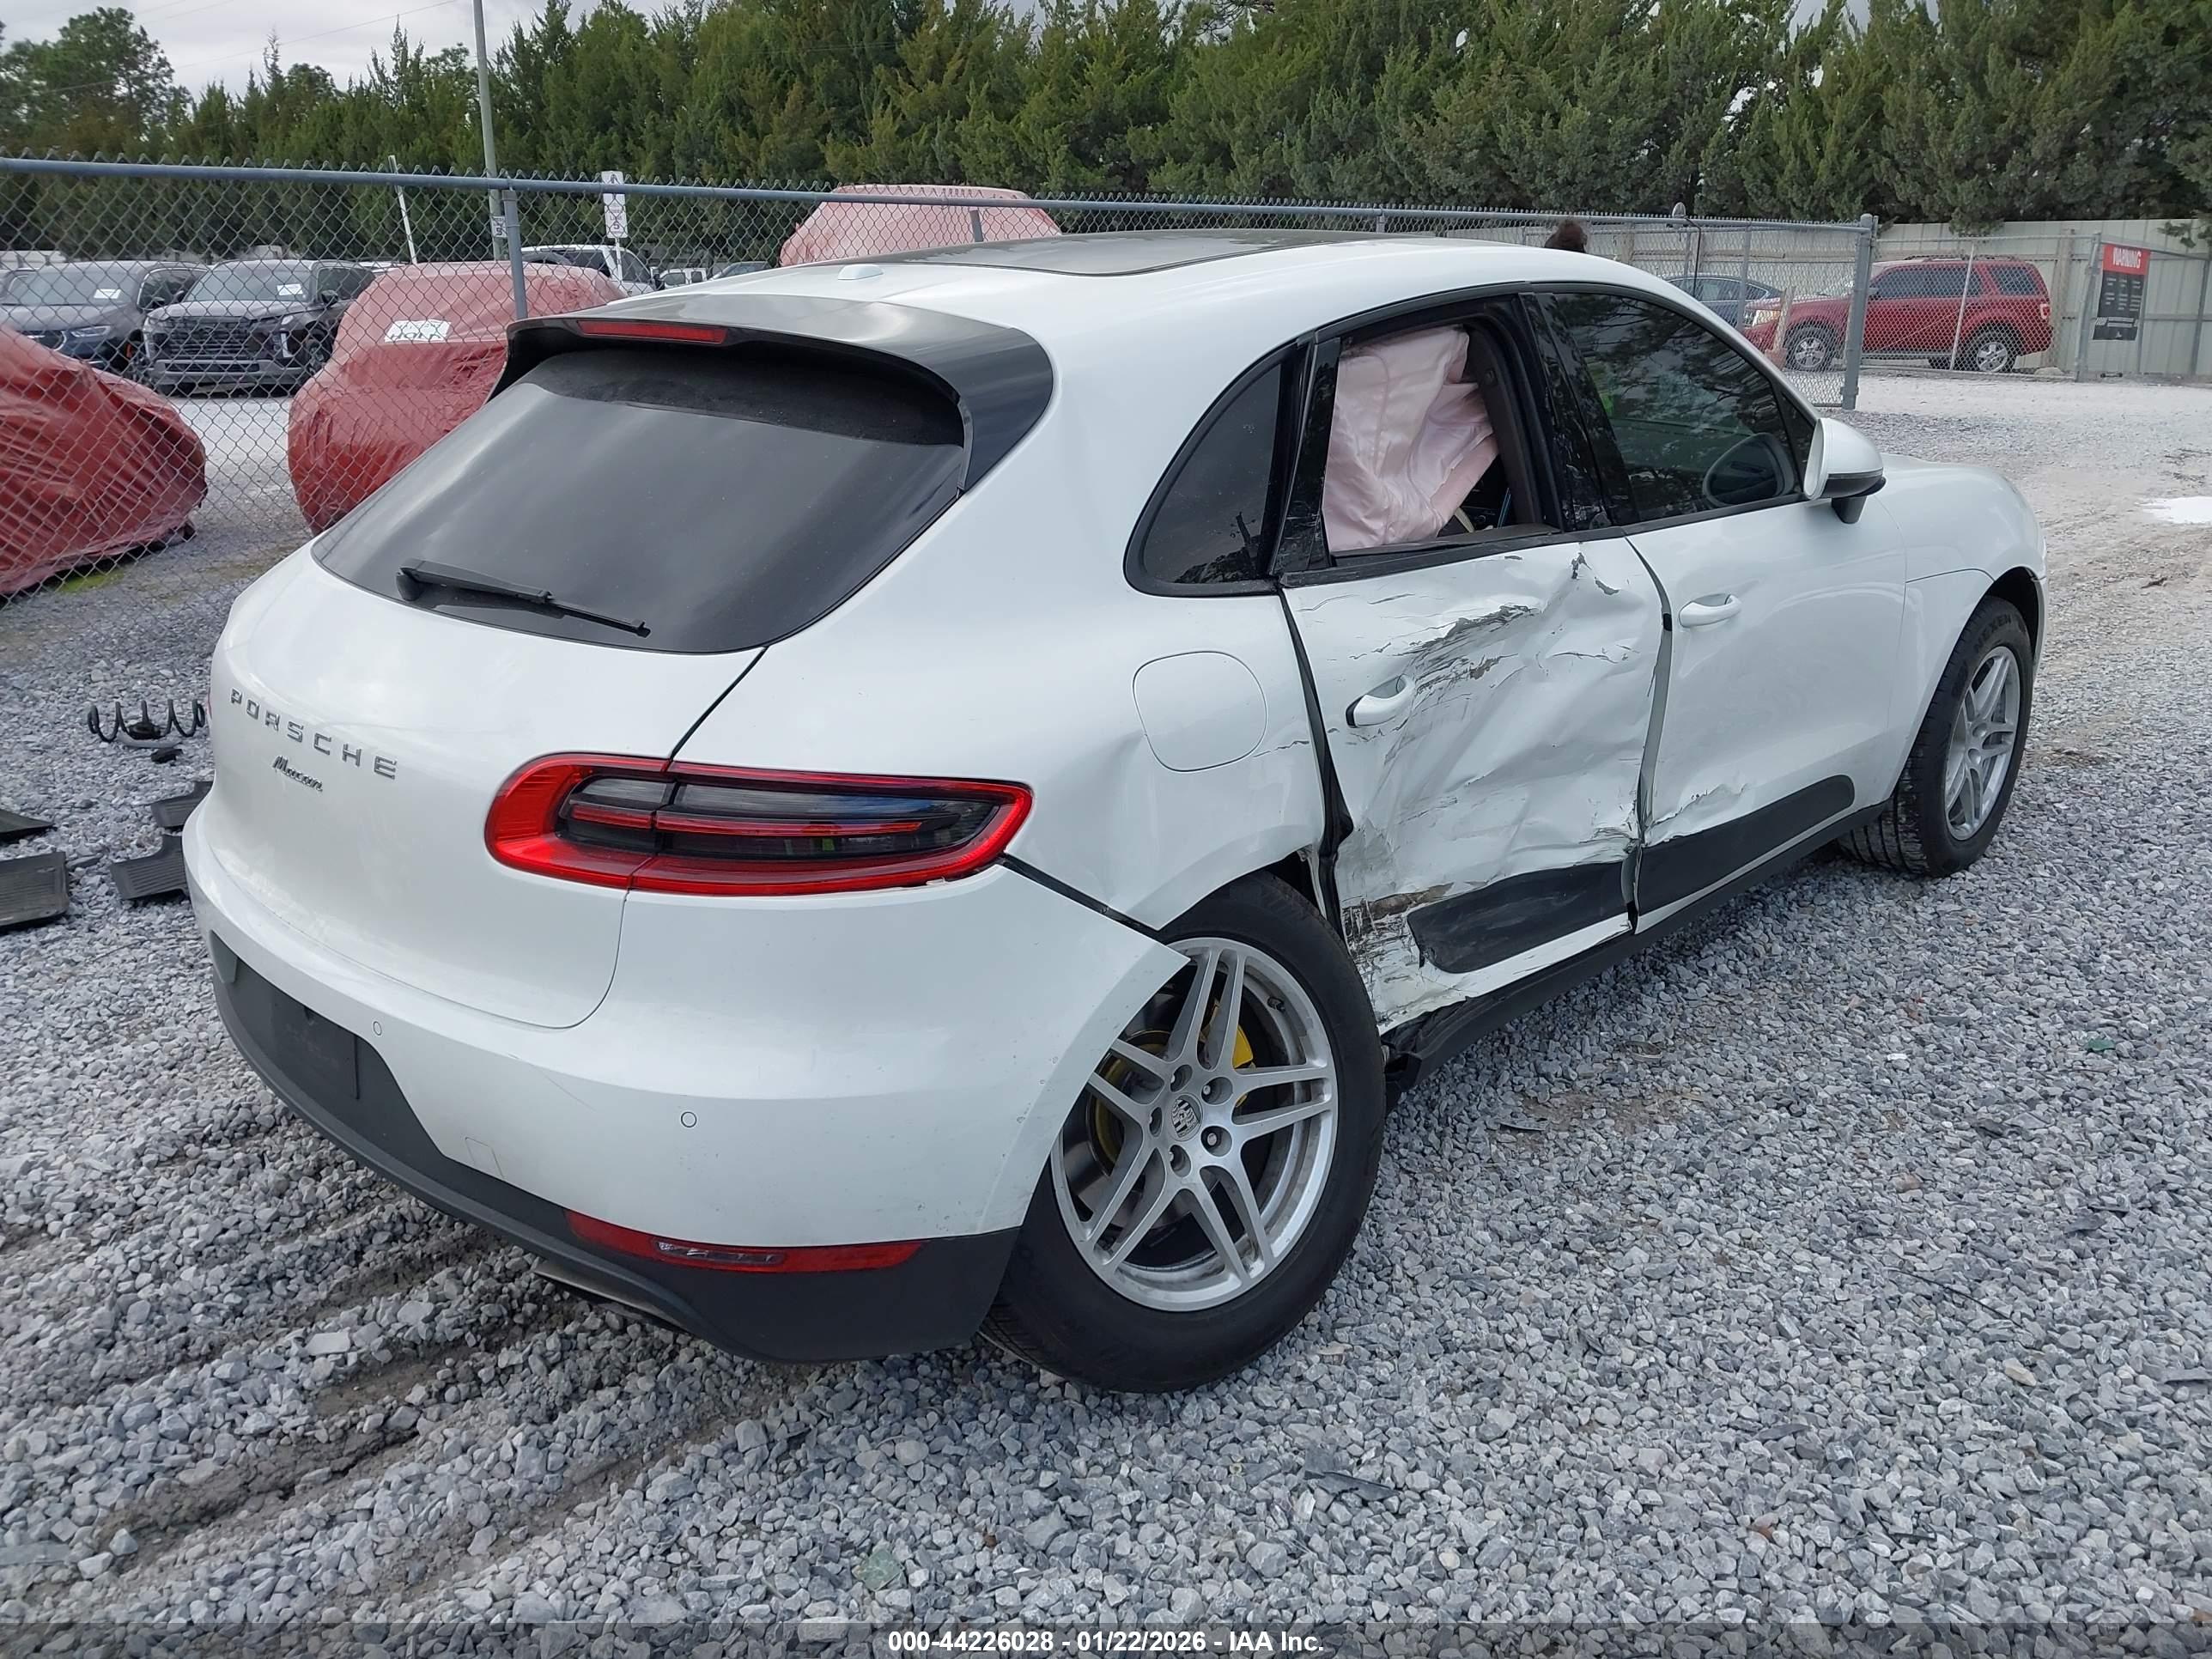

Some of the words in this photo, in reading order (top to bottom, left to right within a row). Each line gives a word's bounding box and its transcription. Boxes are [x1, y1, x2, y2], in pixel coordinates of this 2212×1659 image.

[2112, 246, 2142, 269] WARNING
[230, 687, 398, 781] PORSCHE
[272, 755, 324, 793] Macan
